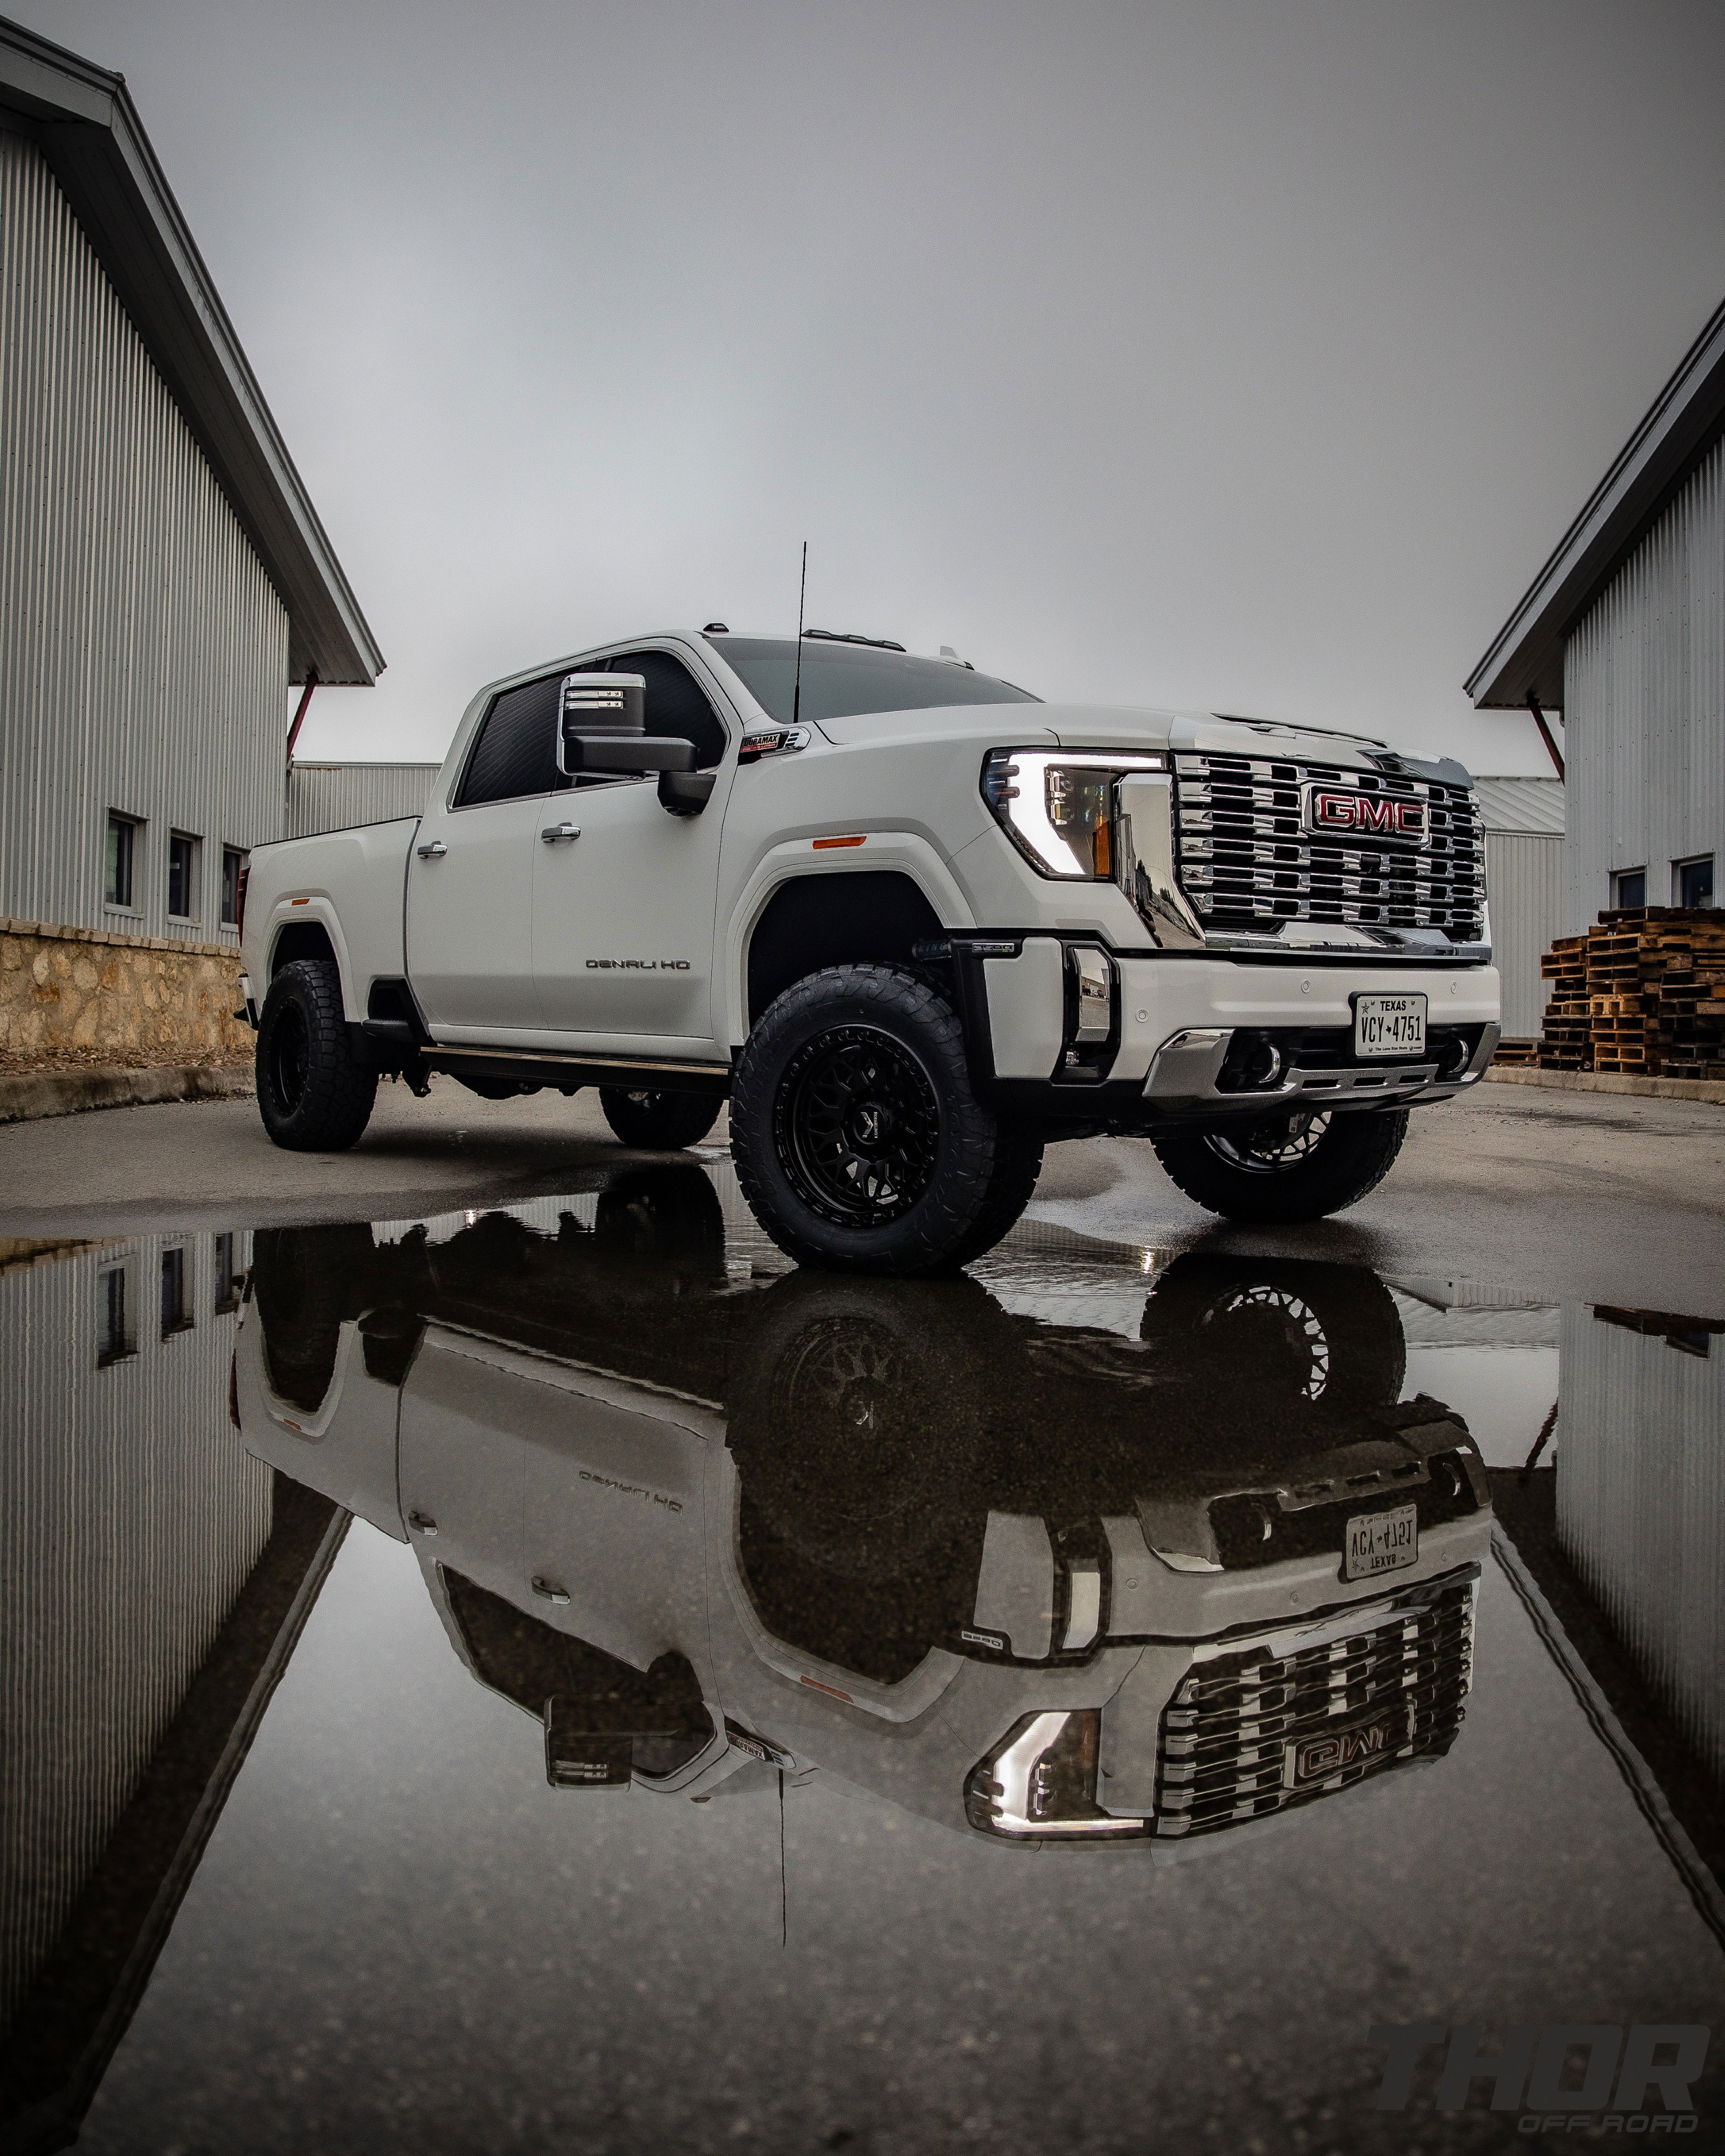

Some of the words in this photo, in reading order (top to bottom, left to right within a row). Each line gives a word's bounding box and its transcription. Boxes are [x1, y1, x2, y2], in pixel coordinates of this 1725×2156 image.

[744, 735, 778, 747] DURAMAX
[1315, 793, 1424, 835] GMC
[585, 959, 657, 969] DENALI
[661, 959, 690, 970] HD
[1380, 1000, 1406, 1011] TEXAS
[1361, 1017, 1384, 1043] VCY
[1392, 1015, 1421, 1041] 4751
